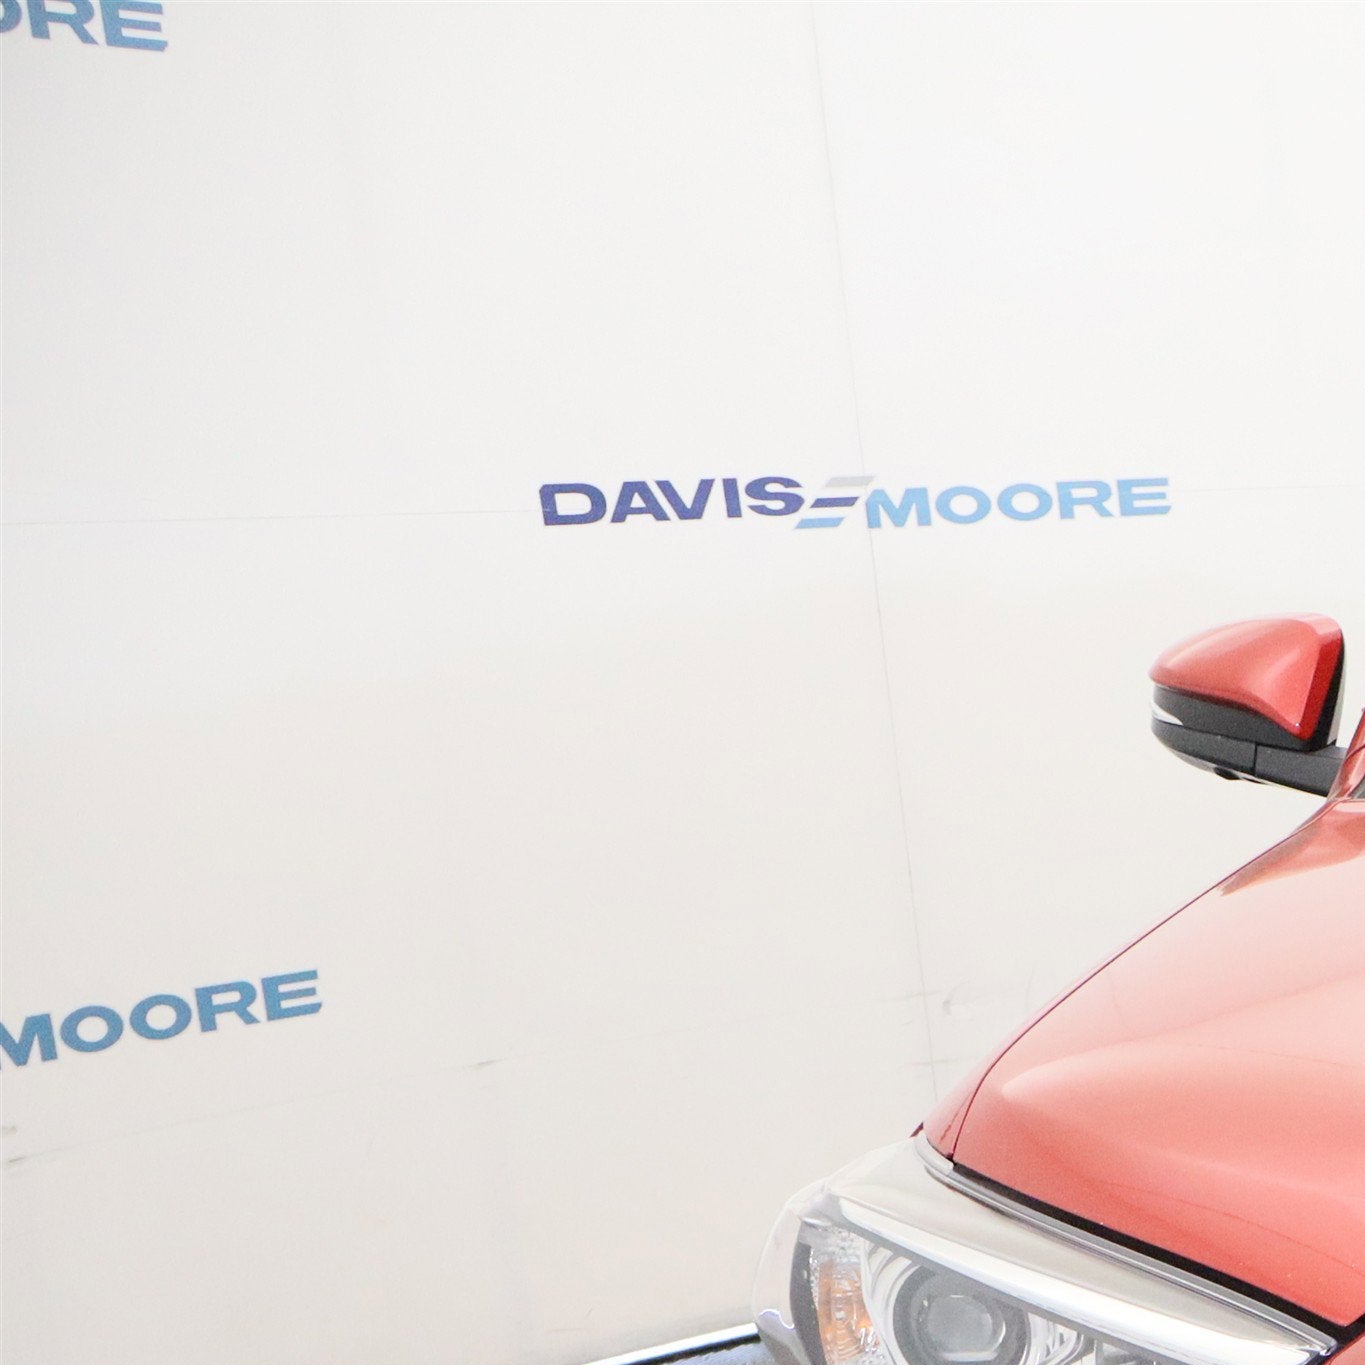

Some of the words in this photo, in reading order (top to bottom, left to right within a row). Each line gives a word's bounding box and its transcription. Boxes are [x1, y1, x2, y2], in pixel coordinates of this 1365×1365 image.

[538, 476, 803, 526] DAVIS
[865, 477, 1173, 529] MOORE
[0, 969, 323, 1069] MOORE
